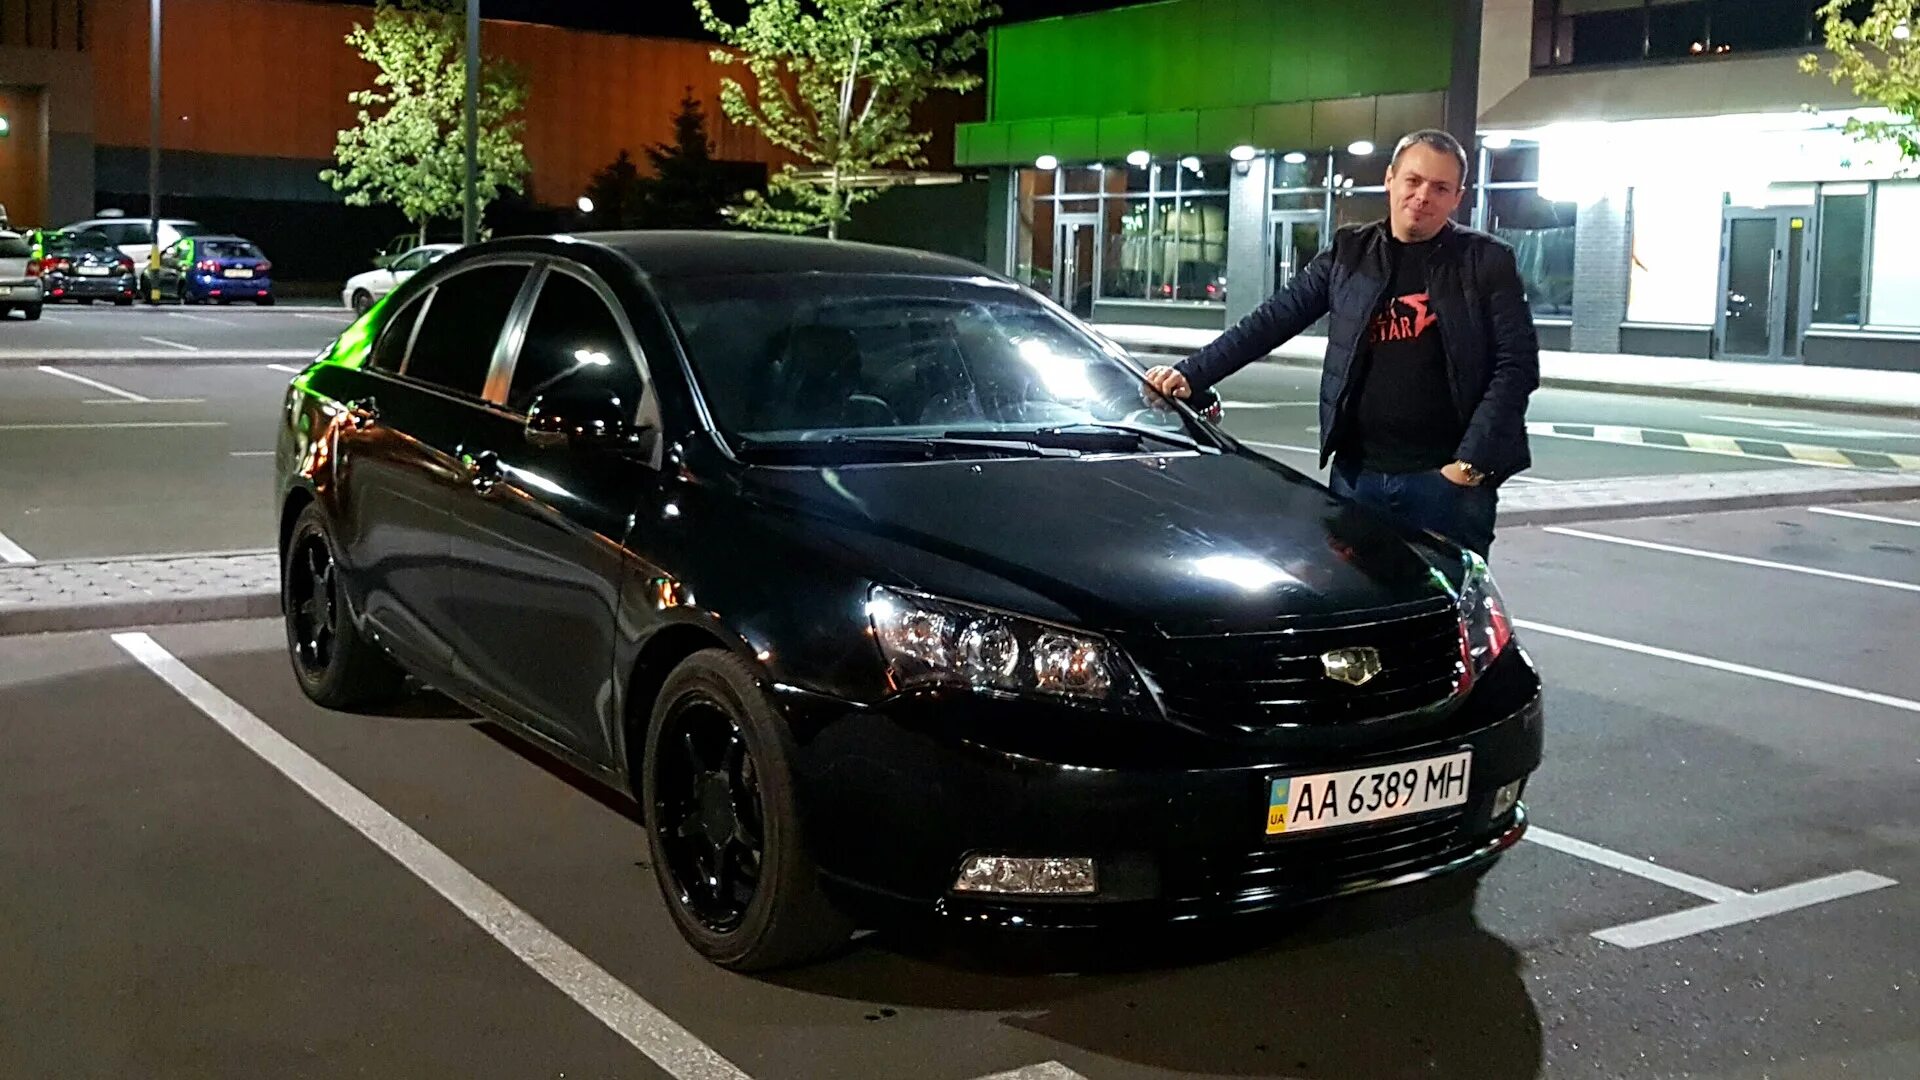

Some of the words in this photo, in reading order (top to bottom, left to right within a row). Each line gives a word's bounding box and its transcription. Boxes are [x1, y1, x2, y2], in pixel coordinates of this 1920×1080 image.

[1291, 780, 1338, 823] AA
[1348, 768, 1418, 814] 6389
[1424, 759, 1467, 802] MH
[1270, 813, 1285, 825] UA
